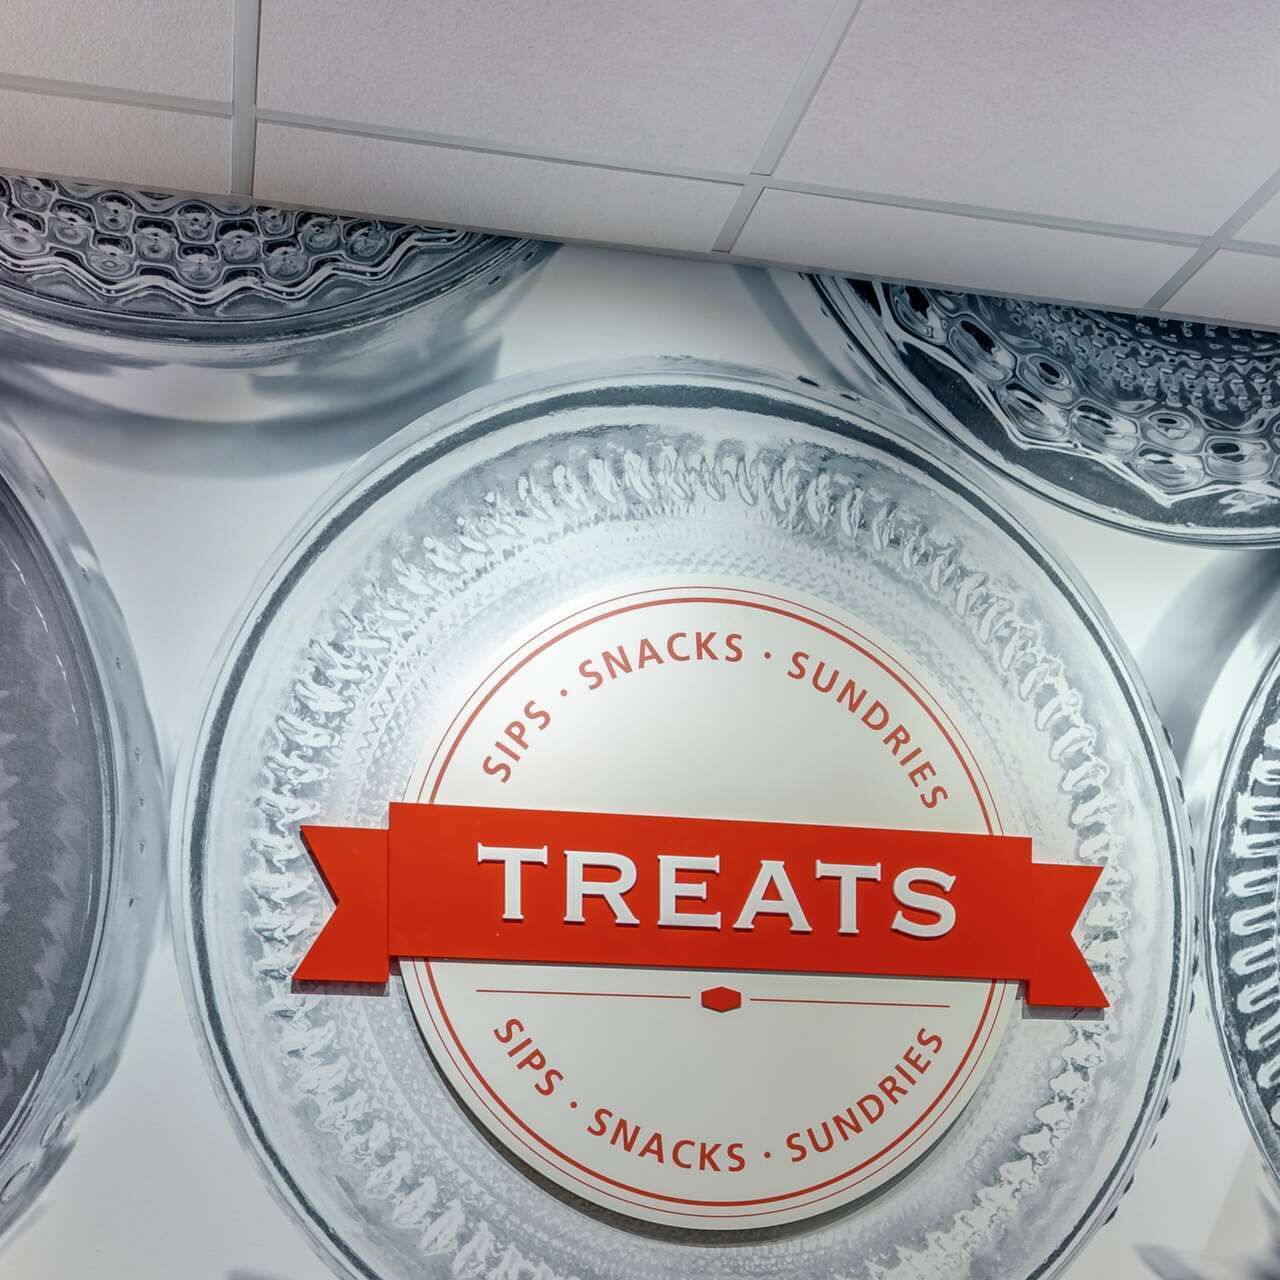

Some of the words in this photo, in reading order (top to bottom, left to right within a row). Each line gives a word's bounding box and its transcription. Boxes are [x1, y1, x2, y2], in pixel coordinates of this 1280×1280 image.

[482, 700, 552, 783] SIPS
[578, 631, 745, 691] SNACKS
[786, 650, 950, 809] SUNDRIES
[476, 842, 957, 939] TREATS
[493, 1017, 565, 1097] SIPS
[586, 1107, 747, 1173] SNACKS
[785, 1026, 944, 1164] SUNDRIES
